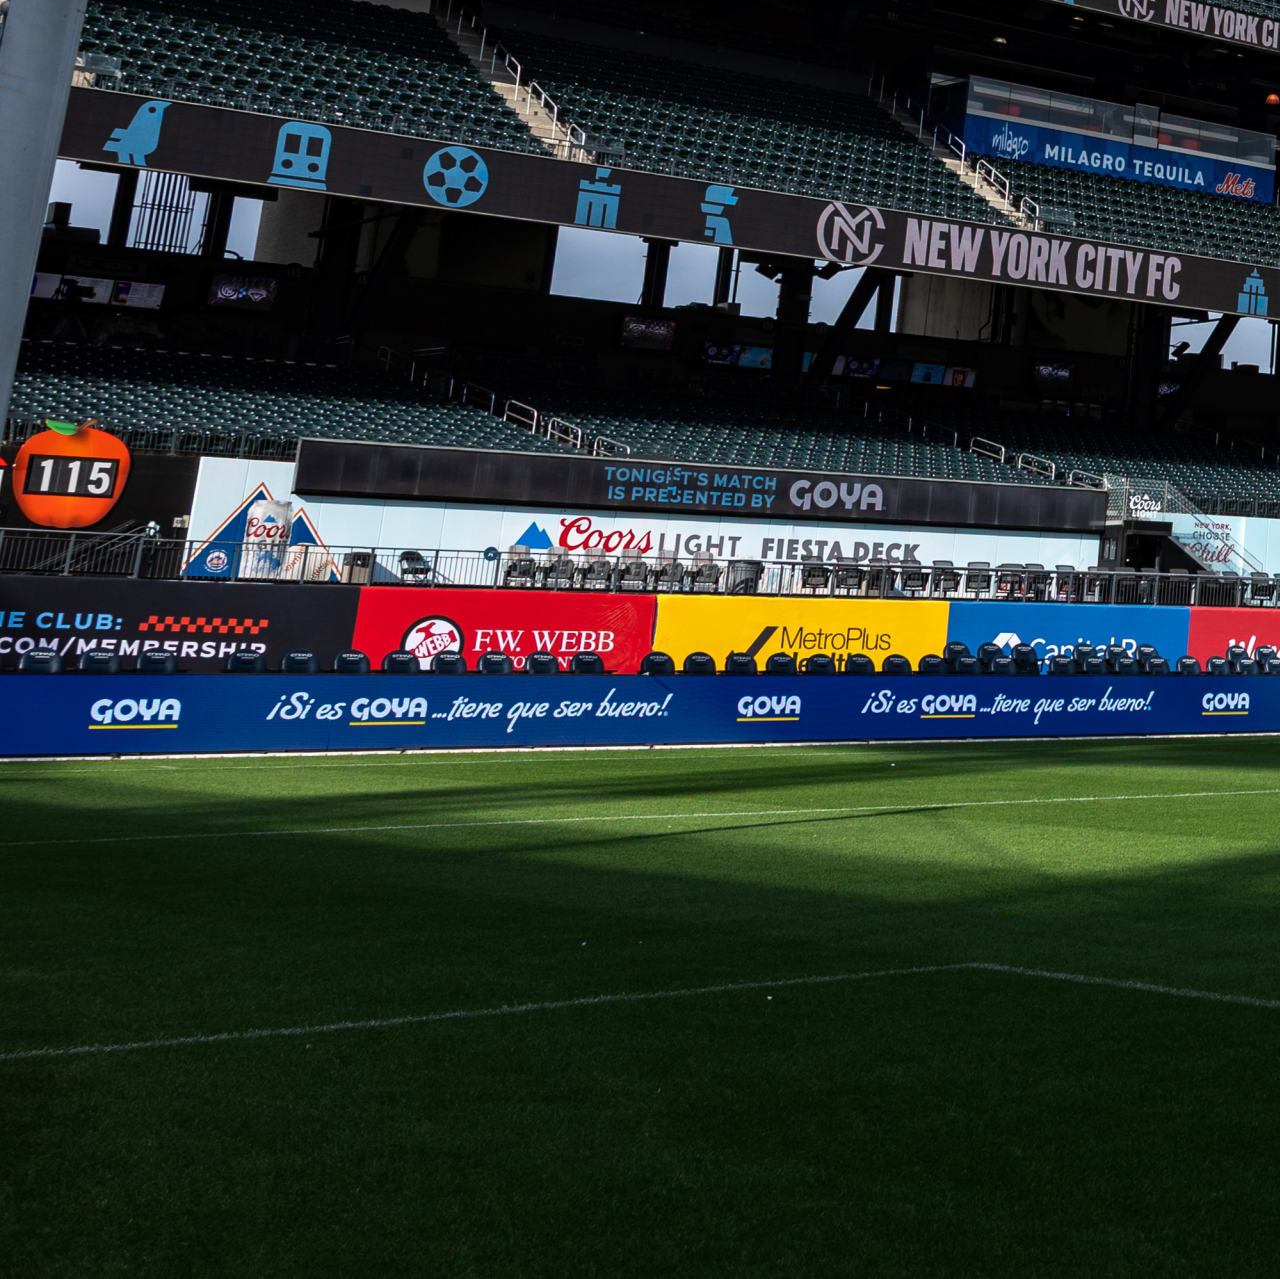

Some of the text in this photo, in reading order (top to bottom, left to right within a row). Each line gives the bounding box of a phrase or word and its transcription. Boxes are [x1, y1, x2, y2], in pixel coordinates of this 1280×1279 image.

[1213, 6, 1258, 44] YORK
[1045, 144, 1126, 171] MILAGRO
[1133, 159, 1205, 186] TEQUILA
[1216, 172, 1256, 198] Mets
[902, 217, 1182, 301] NEW YORK CITY FC
[40, 459, 112, 494] 115
[713, 473, 777, 490] MATCH
[608, 486, 776, 509] IS BY
[790, 479, 884, 511] GOYA
[1130, 496, 1161, 511] Coors
[246, 517, 291, 539] Coors
[559, 516, 922, 562] Coors LIGHT FIESTA DECK
[1192, 531, 1231, 541] CHOOSE
[35, 611, 122, 630] CLUB:
[414, 633, 451, 658] WEBB
[472, 629, 615, 653] F.W. WEBB
[780, 626, 892, 651] MetroPlus
[90, 697, 181, 722] GOYA
[316, 700, 344, 719] es
[350, 697, 427, 720] GOYA
[507, 700, 549, 734] que
[553, 700, 593, 718] ser
[596, 688, 672, 718] bueno!
[737, 695, 800, 717] GOYA
[896, 699, 918, 713] es
[921, 694, 977, 713] GOYA
[1033, 696, 1063, 724] que
[1071, 696, 1096, 711] ser
[1098, 686, 1154, 711] bueno!
[1202, 692, 1250, 711] GOYA
